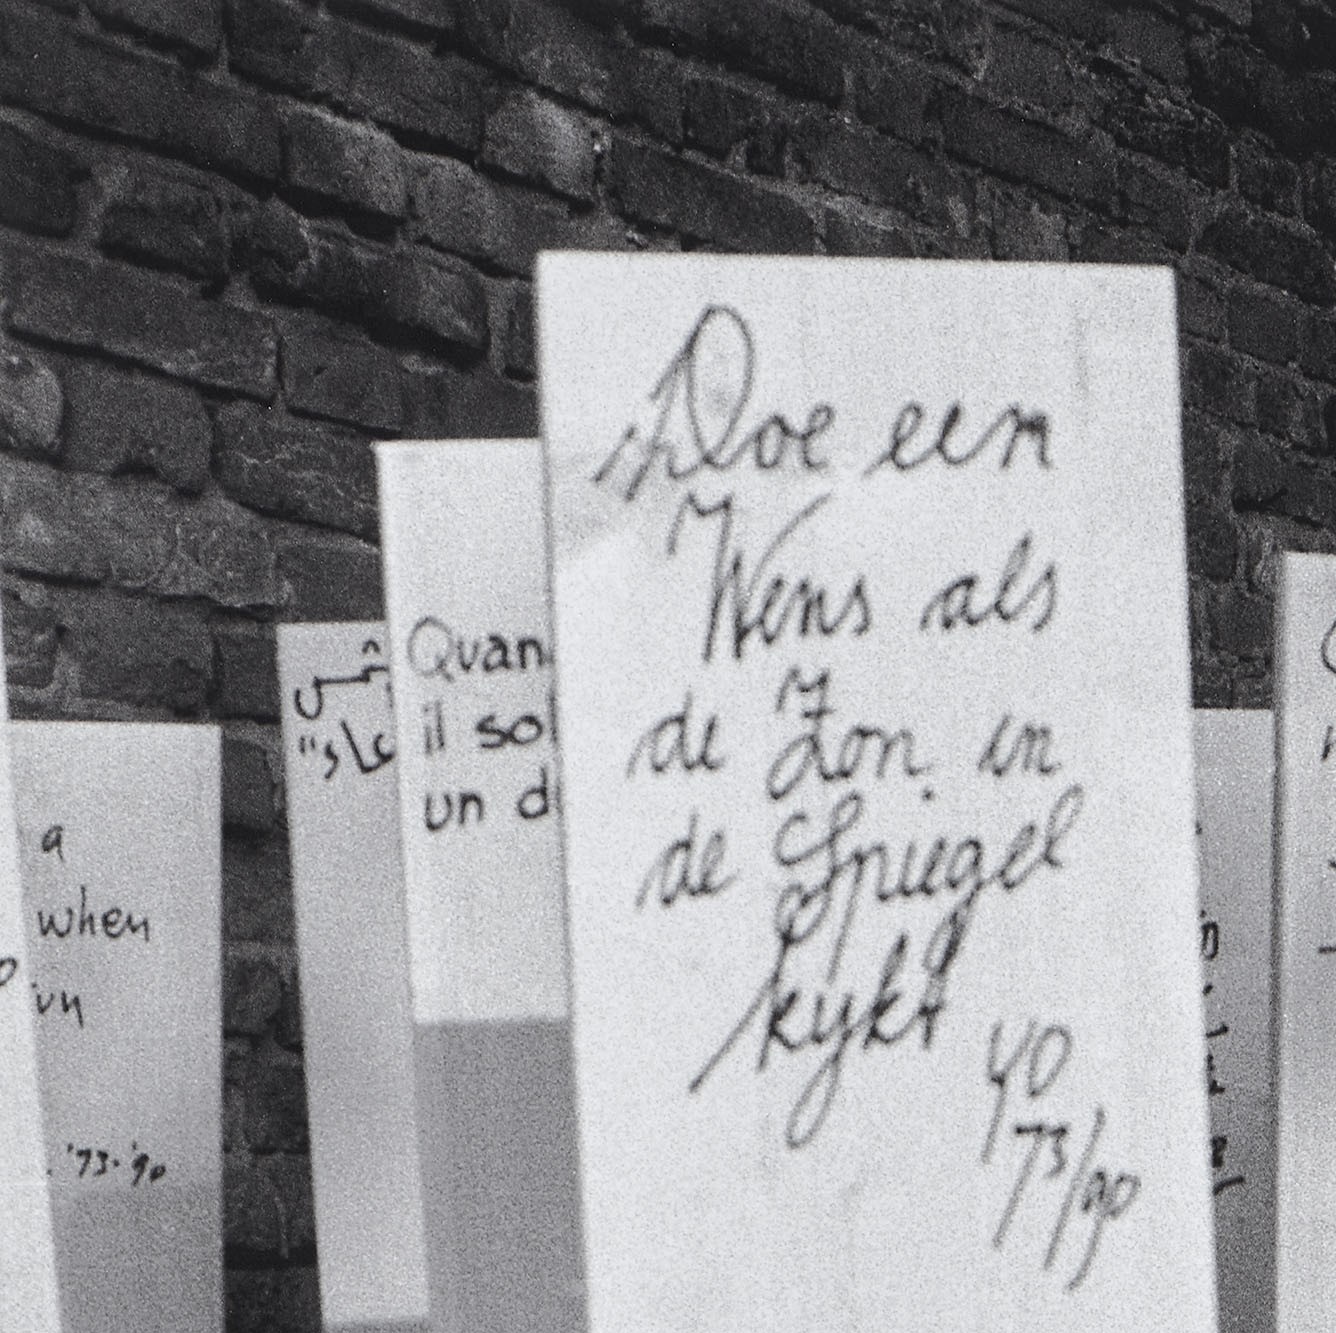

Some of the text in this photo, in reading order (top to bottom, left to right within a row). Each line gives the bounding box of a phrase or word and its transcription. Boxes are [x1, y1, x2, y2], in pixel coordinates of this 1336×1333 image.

[592, 303, 1055, 502] Doe een
[667, 492, 1060, 662] Wens als
[406, 616, 553, 684] Quan
[422, 700, 446, 757] il
[626, 665, 1062, 801] de Zon in
[424, 790, 484, 832] un
[636, 813, 738, 908] de
